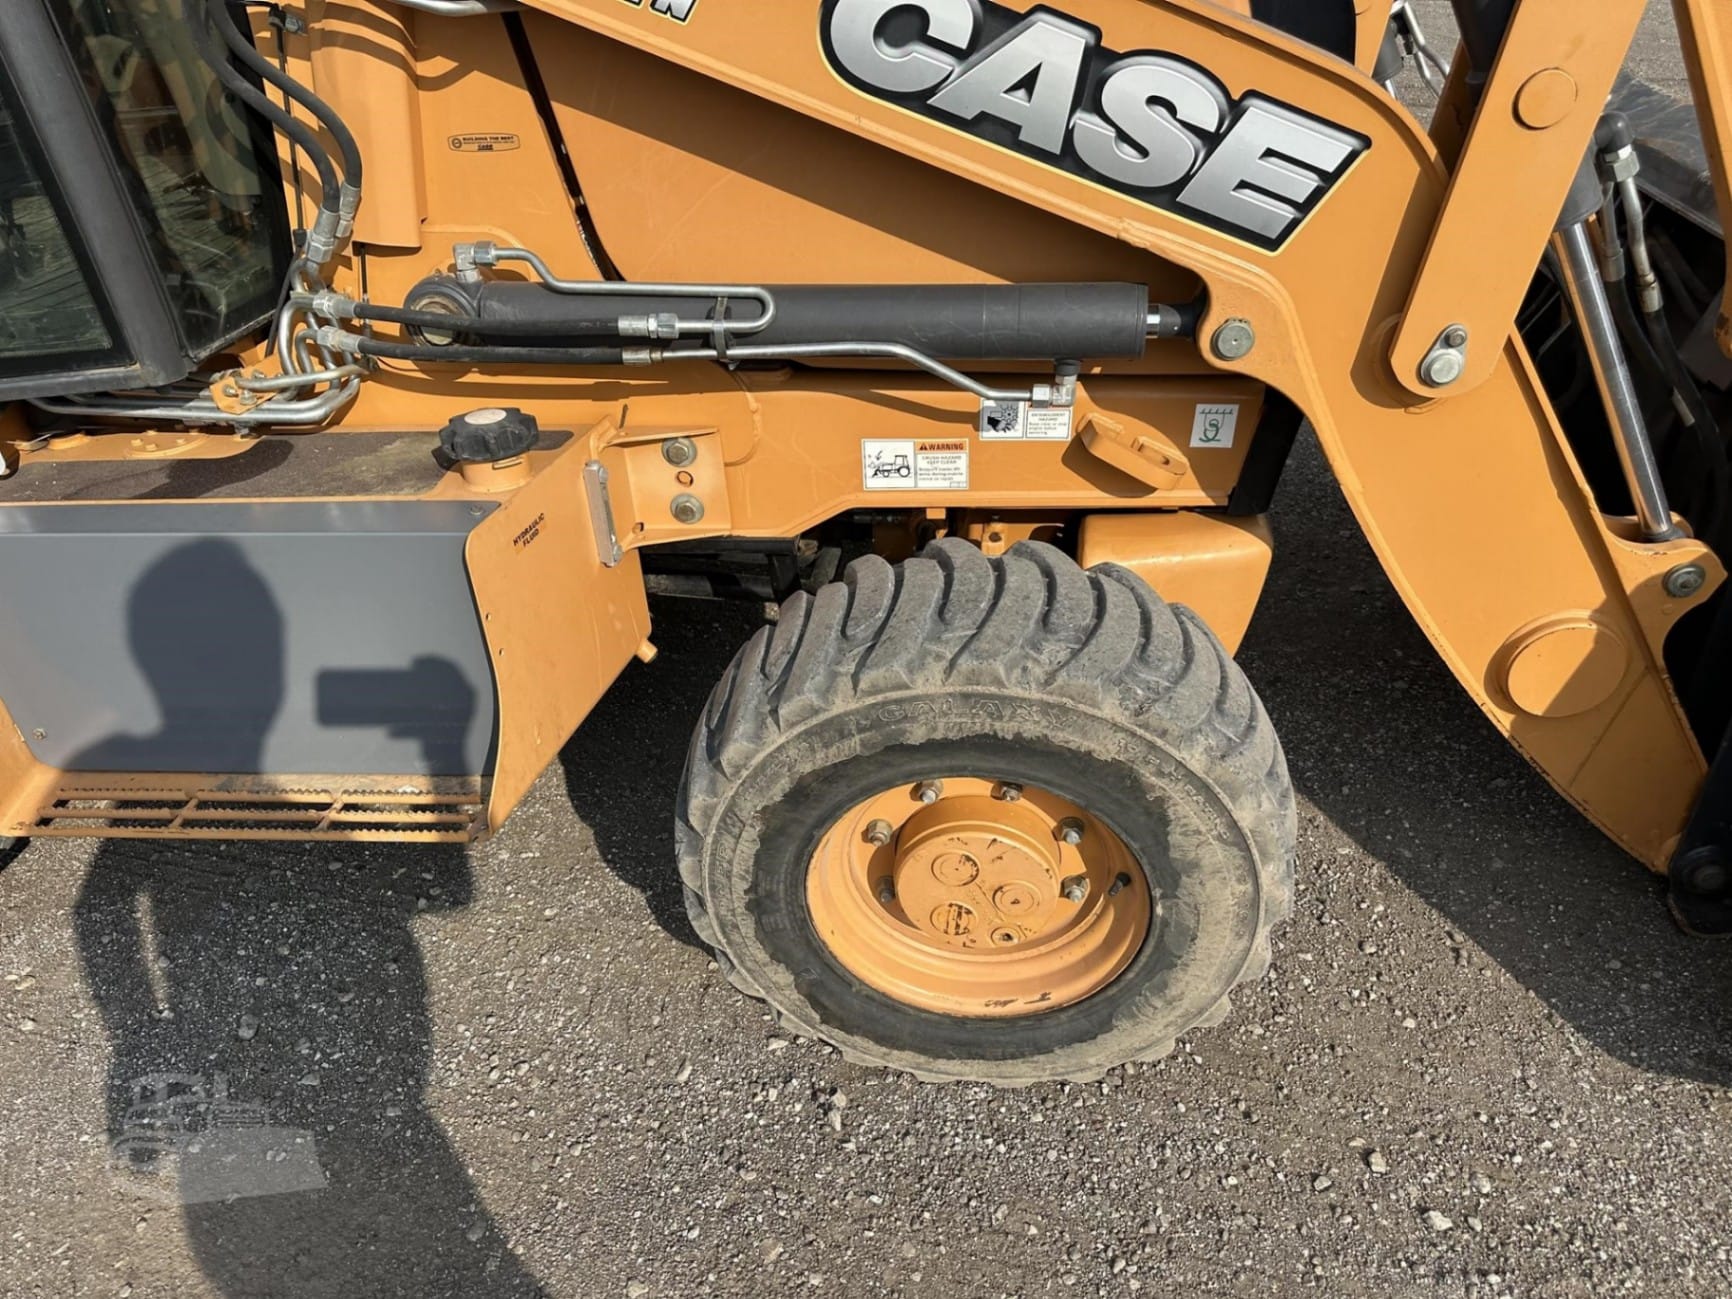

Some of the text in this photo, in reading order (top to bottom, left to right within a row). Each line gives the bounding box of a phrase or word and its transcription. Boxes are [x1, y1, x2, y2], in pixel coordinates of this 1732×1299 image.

[826, 0, 1358, 243] CASE
[928, 442, 964, 451] WARNING
[512, 512, 545, 547] HYDRAULIC
[522, 527, 540, 548] FLUID
[878, 698, 1087, 729] GALAXY
